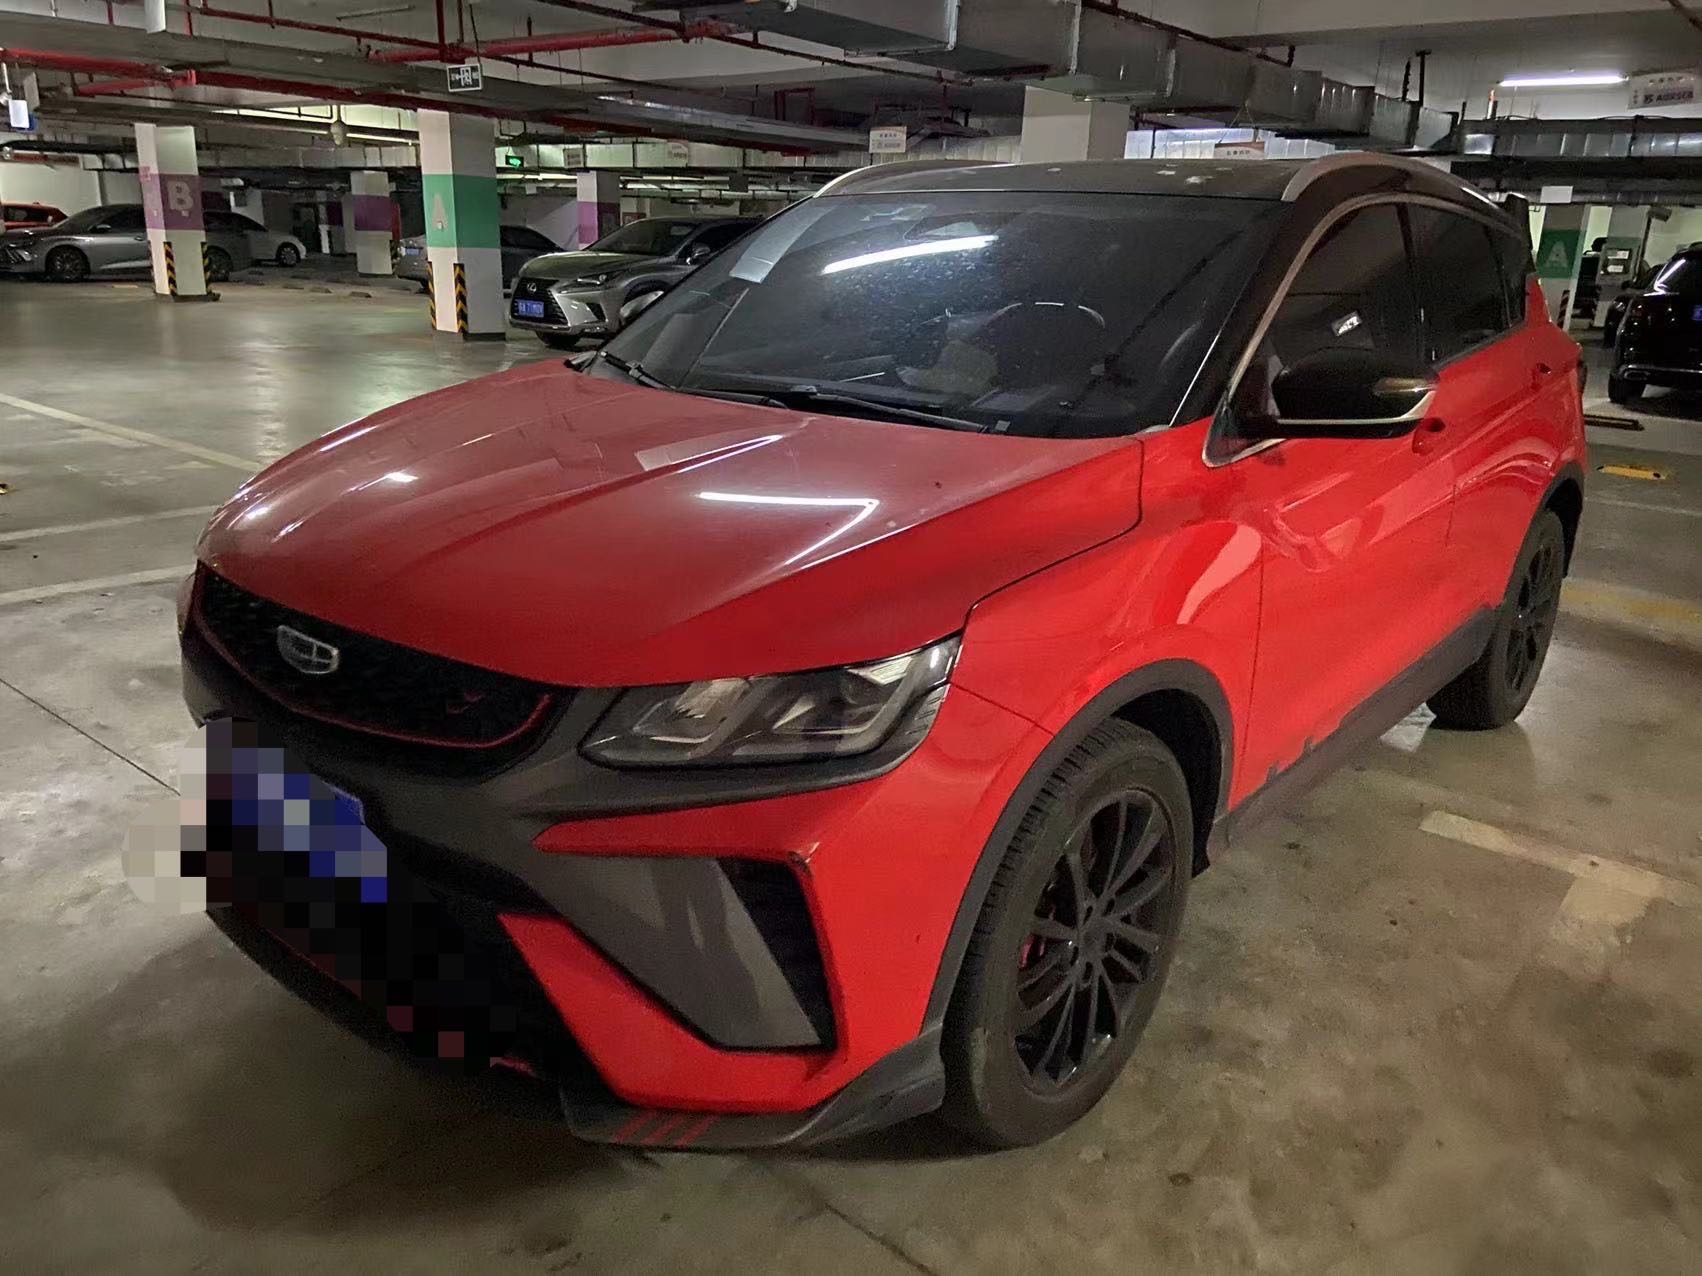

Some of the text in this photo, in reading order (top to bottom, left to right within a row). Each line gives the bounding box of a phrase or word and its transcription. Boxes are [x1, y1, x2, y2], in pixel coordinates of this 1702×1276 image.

[167, 181, 193, 209] B
[432, 192, 447, 229] A
[1545, 240, 1568, 268] A
